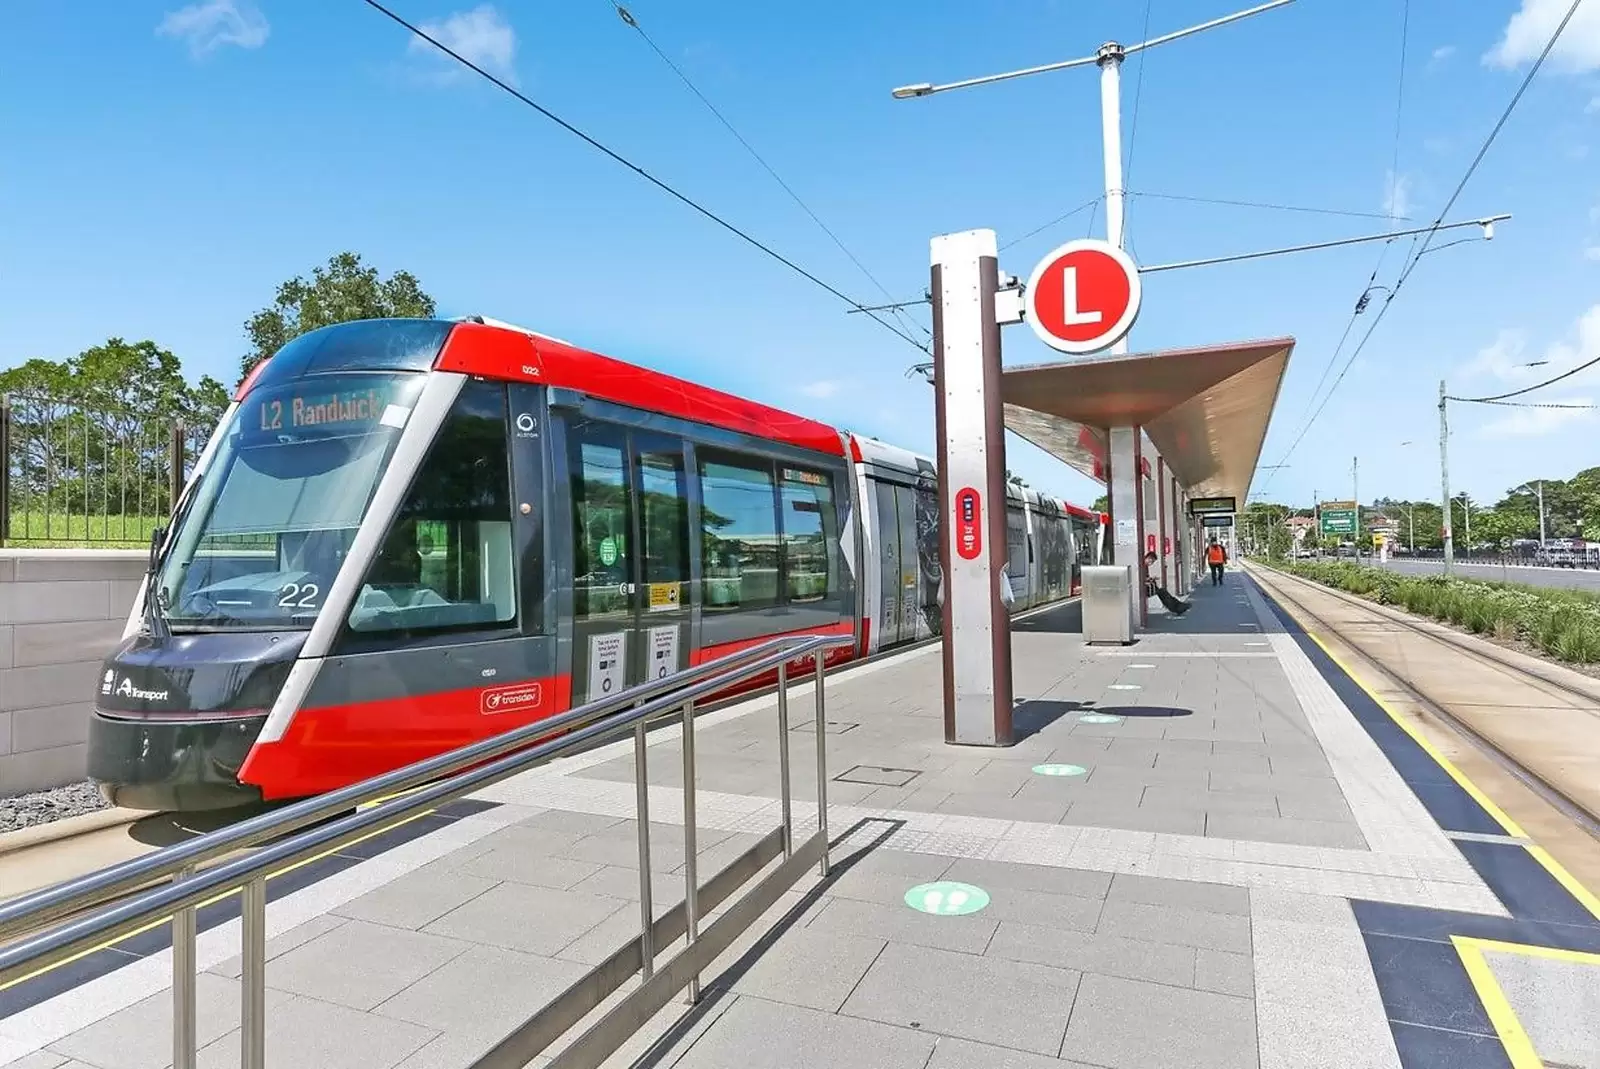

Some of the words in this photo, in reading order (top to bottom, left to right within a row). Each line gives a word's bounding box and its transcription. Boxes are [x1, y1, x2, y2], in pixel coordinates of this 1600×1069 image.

[1063, 266, 1102, 326] L
[260, 401, 282, 430] L2
[292, 389, 379, 427] Randwick
[278, 583, 319, 608] 22
[131, 687, 168, 701] Transport
[502, 693, 536, 705] transdev
